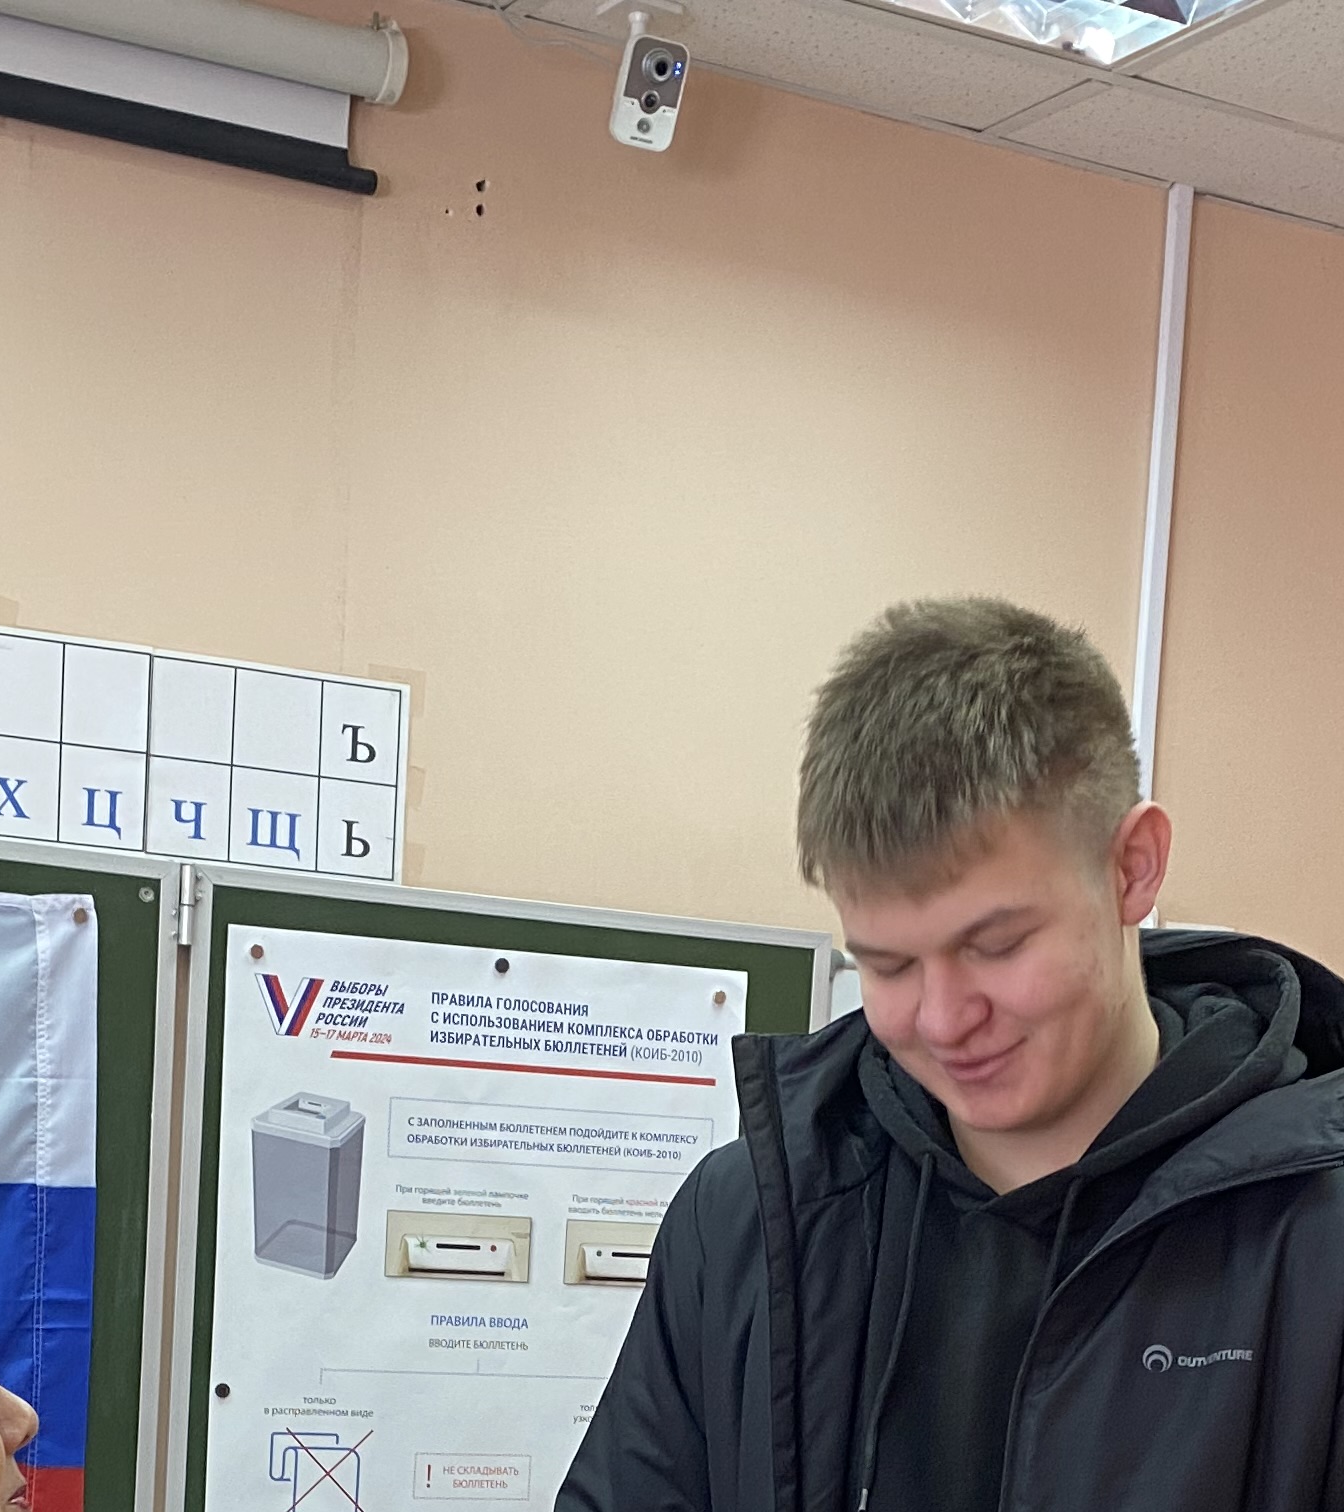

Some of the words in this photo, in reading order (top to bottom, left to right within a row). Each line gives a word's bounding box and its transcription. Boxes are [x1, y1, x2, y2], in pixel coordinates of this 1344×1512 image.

[330, 980, 389, 997] ВЫБОРЫ
[322, 996, 405, 1015] ПРЕЗИДЕНТА
[431, 992, 493, 1009] ПРАВИЛА
[496, 998, 589, 1017] ГОЛОСОВАНИЯ
[315, 1012, 369, 1028] РОССИИ
[431, 1011, 439, 1024] С
[443, 1012, 564, 1034] ИСПОЛЬЗОВАНИЕМ
[567, 1022, 643, 1040] КОМПЛЕКСА
[646, 1028, 718, 1046] ОБРАБОТКИ
[336, 1029, 368, 1043] МАРТА
[369, 1032, 393, 1045] 2024
[430, 1030, 541, 1051] ИЗБИРАТЕЛЬНЫХ
[544, 1039, 627, 1057] БЮЛЛЕТЕНЕЙ
[630, 1045, 703, 1066] (КОИБ-2010)
[408, 1117, 415, 1127] С
[417, 1117, 497, 1132] ЗАПОЛНЕННЫМ
[499, 1122, 567, 1136] БЮЛЛЕТЕНЕМ
[569, 1127, 629, 1140] ПОДОЙДИТЕ
[631, 1132, 638, 1140] К
[639, 1132, 698, 1144] КОМПЛЕКСУ
[407, 1134, 468, 1147] ОБРАБОТКИ
[470, 1138, 555, 1152] ИЗБИРАТЕЛЬНЫХ
[556, 1143, 621, 1156] БЮЛЛЕТЕНЕЙ
[623, 1148, 681, 1161] (КОИБ-2010)
[396, 1184, 413, 1194] При
[572, 1194, 589, 1204] При
[431, 1315, 486, 1328] ПРАВИЛА
[489, 1316, 529, 1330] ВВОДА
[428, 1338, 471, 1349] ВВОДИТЕ
[473, 1340, 529, 1351] БЮЛЛЕТЕНЬ
[303, 1396, 337, 1405] только
[264, 1407, 269, 1415] в
[271, 1407, 349, 1418] расправленном
[350, 1409, 374, 1418] виде
[443, 1466, 456, 1475] НЕ
[457, 1466, 519, 1476] СКЛАДЫВАТЬ
[452, 1479, 508, 1489] БЮЛЛЕТЕНЬ
